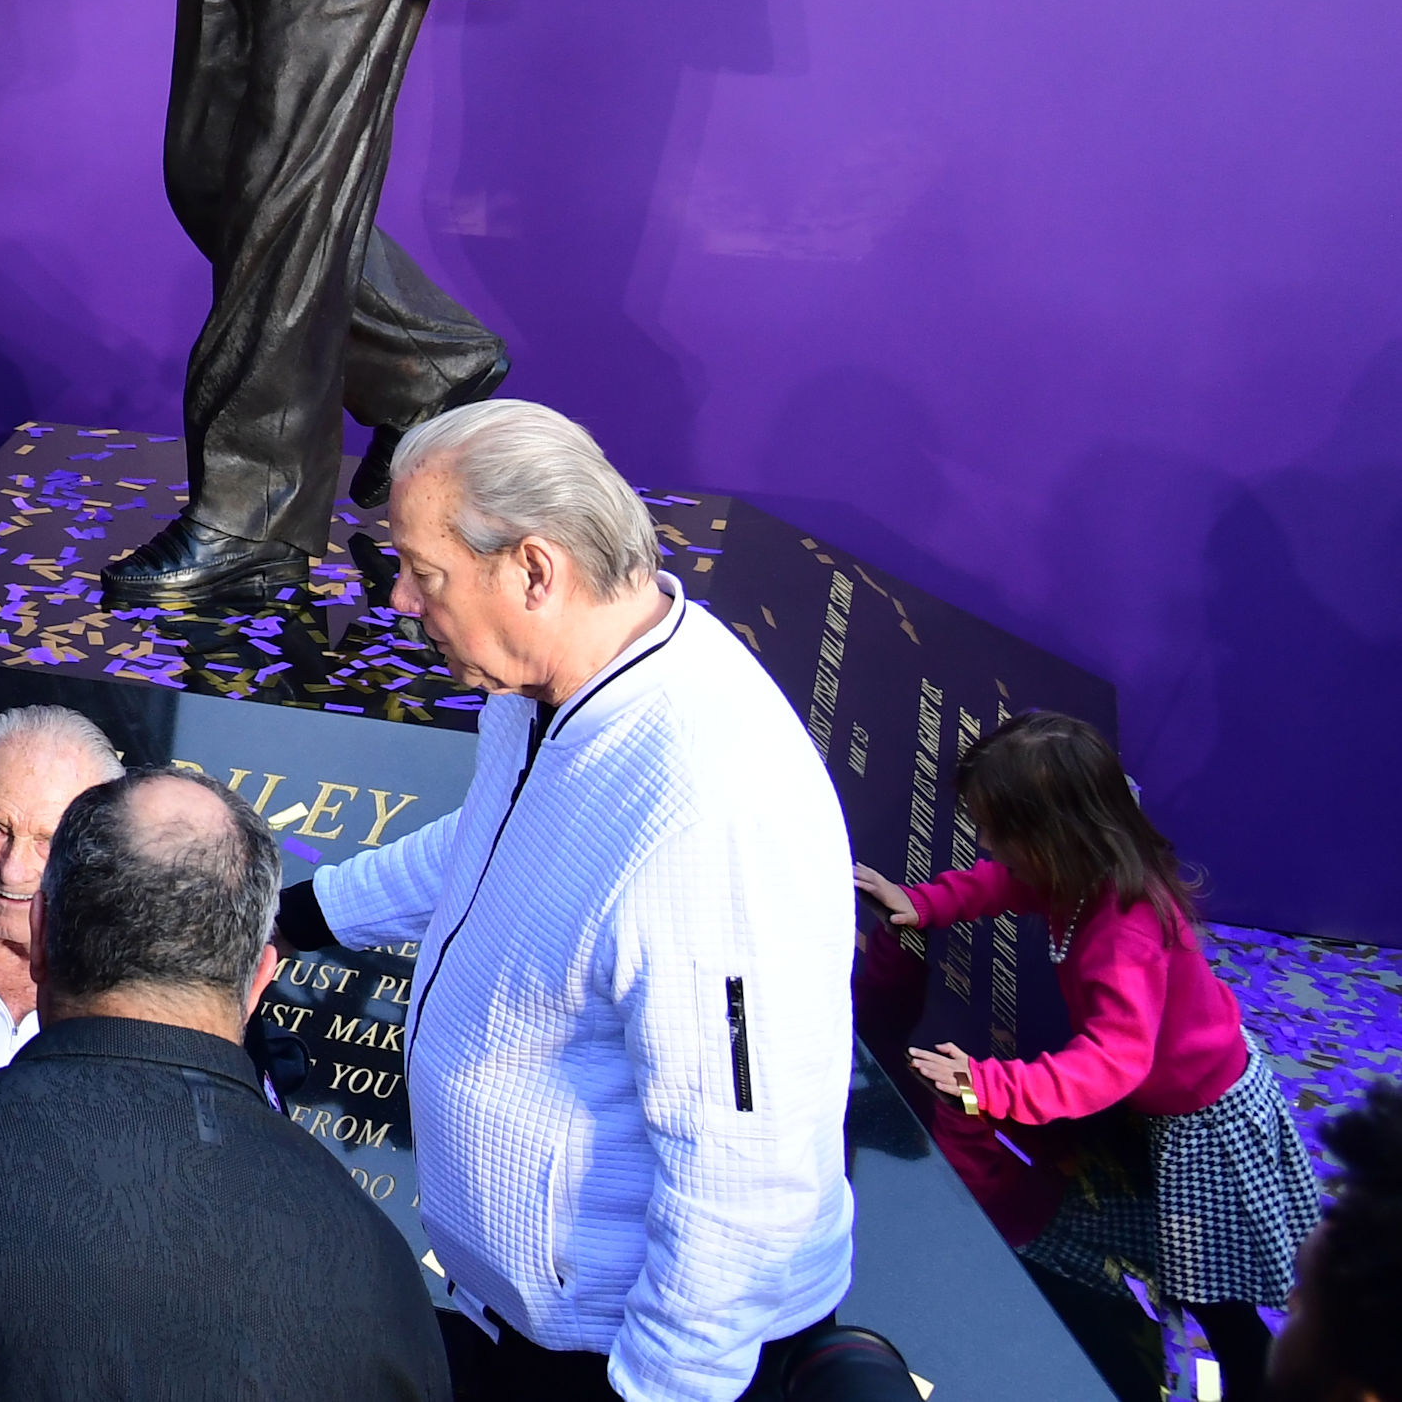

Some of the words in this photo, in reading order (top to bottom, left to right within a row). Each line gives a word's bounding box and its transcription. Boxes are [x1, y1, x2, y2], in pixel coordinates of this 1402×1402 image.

[825, 603, 849, 639] NOT
[820, 629, 845, 670] WILL
[917, 695, 942, 761] AGAINST
[915, 750, 938, 780] OR
[913, 770, 937, 802] US
[910, 791, 935, 843] WITH
[992, 933, 1017, 967] IN
[991, 958, 1017, 1033] EITHER
[328, 1062, 403, 1099] YOU
[289, 1104, 397, 1152] FROM.
